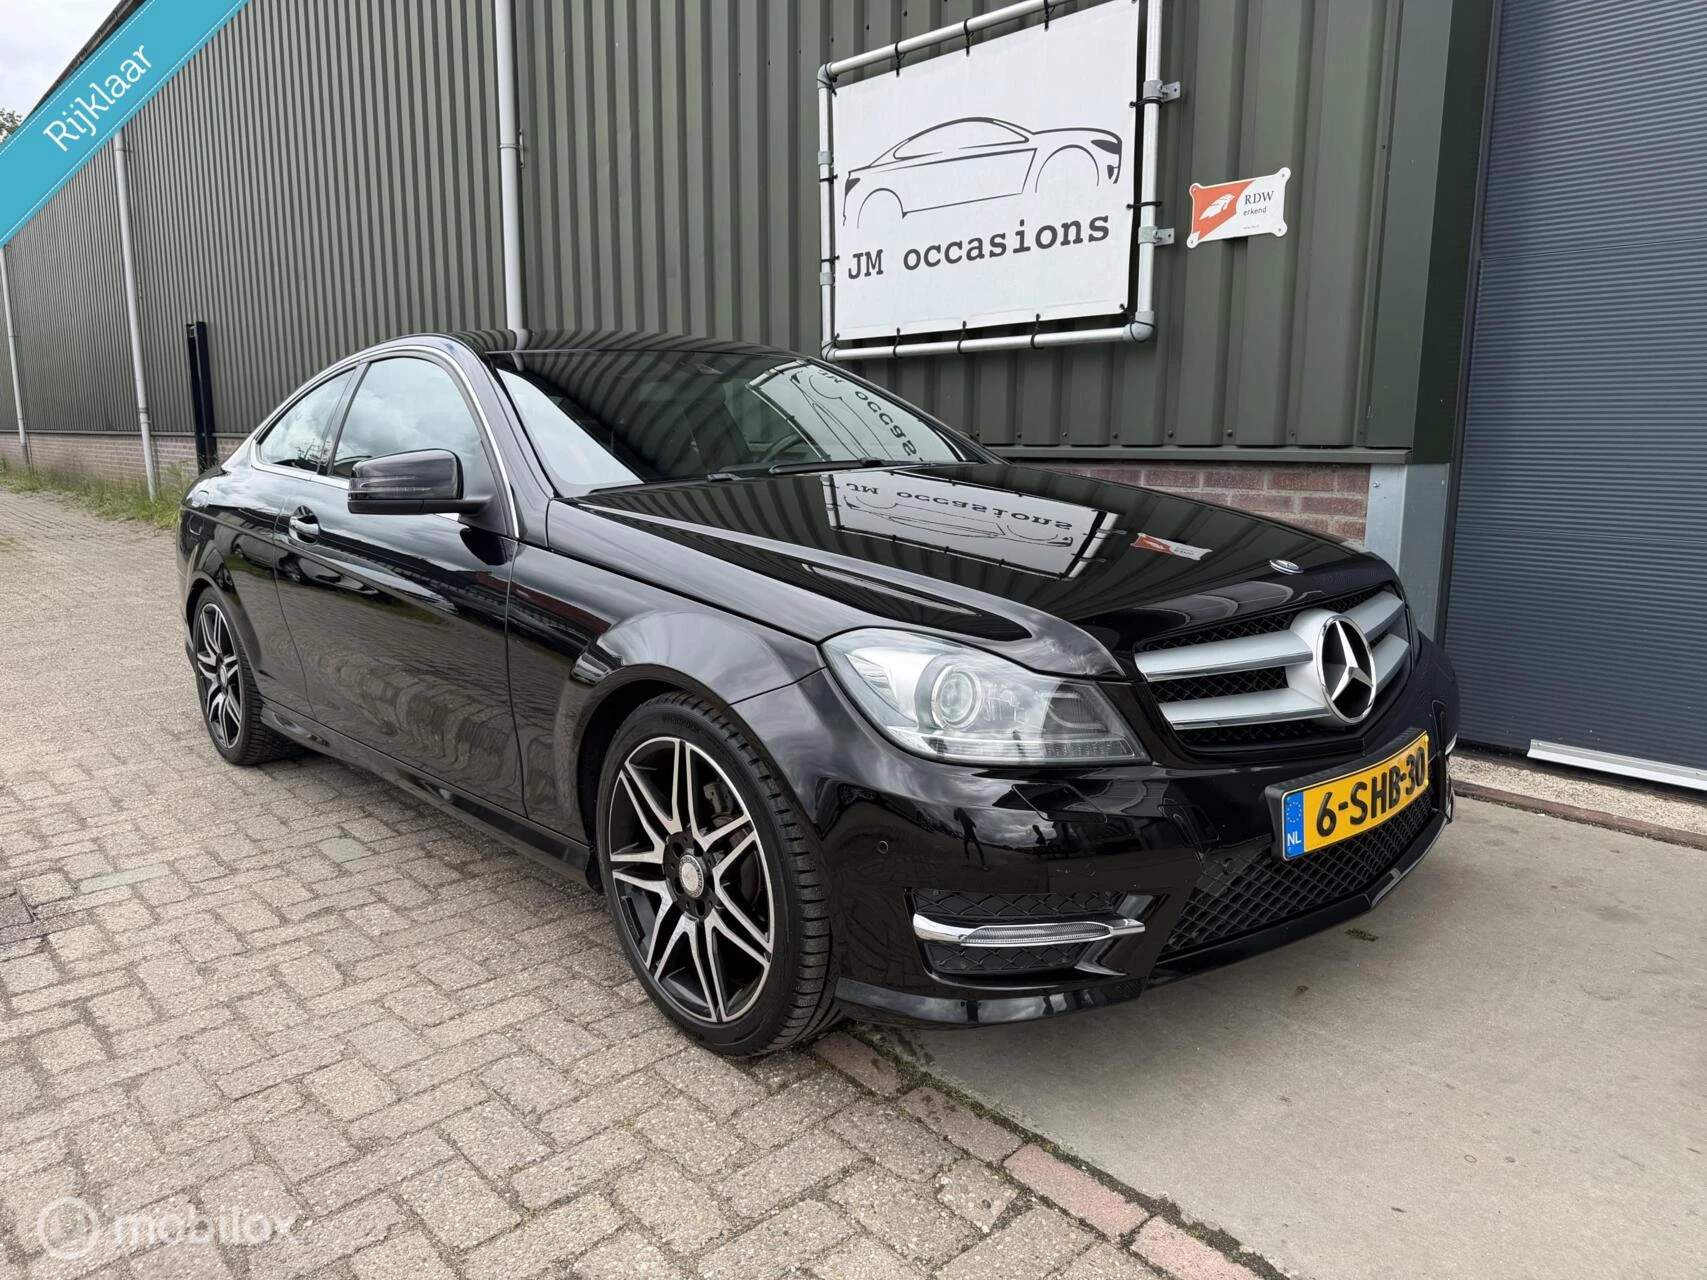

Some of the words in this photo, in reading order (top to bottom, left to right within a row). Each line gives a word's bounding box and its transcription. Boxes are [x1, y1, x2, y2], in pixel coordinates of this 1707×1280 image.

[1244, 190, 1274, 205] RDW
[1243, 206, 1267, 216] erkend
[848, 249, 884, 280] JM
[903, 214, 1110, 271] occasions
[1316, 746, 1426, 837] 6-SHB-30
[1287, 830, 1302, 847] NL
